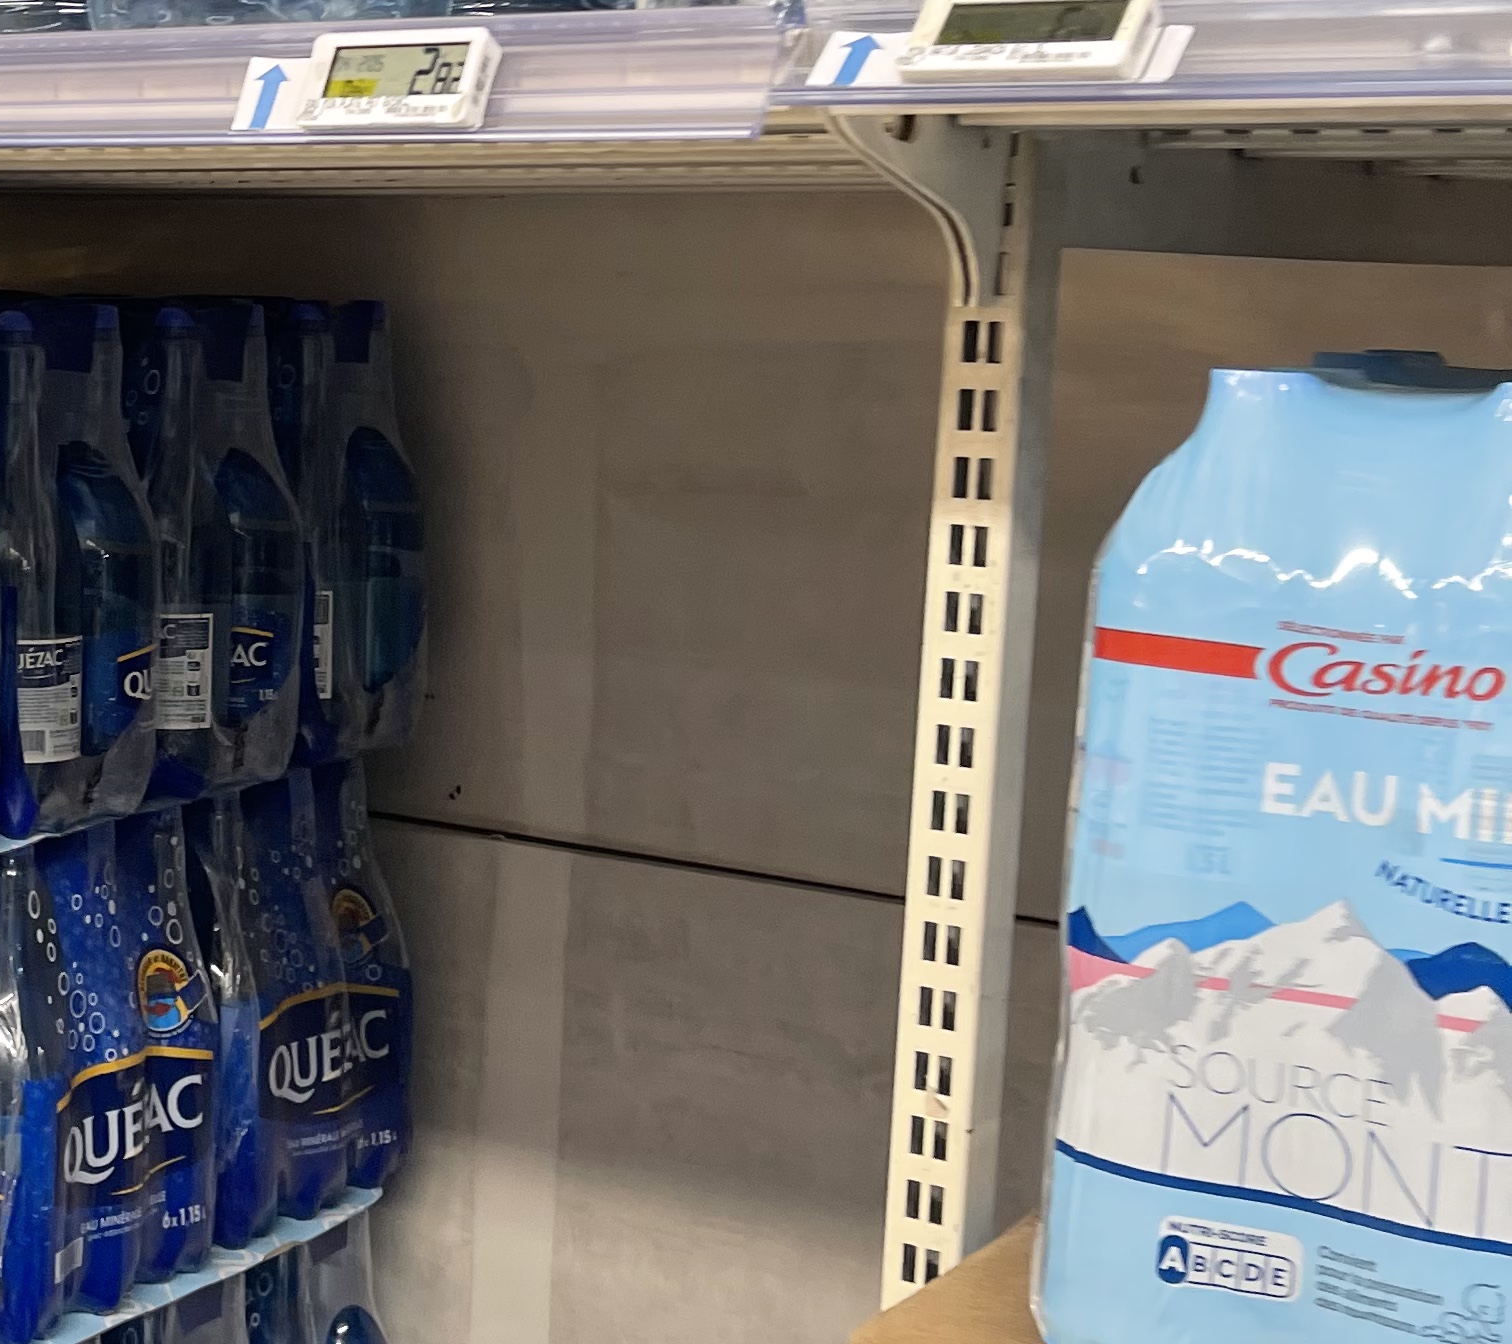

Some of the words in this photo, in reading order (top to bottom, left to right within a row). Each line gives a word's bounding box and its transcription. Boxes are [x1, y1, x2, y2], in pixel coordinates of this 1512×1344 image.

[1268, 641, 1507, 702] Casino
[1259, 761, 1400, 827] EAU
[1168, 1044, 1395, 1129] SOURCE
